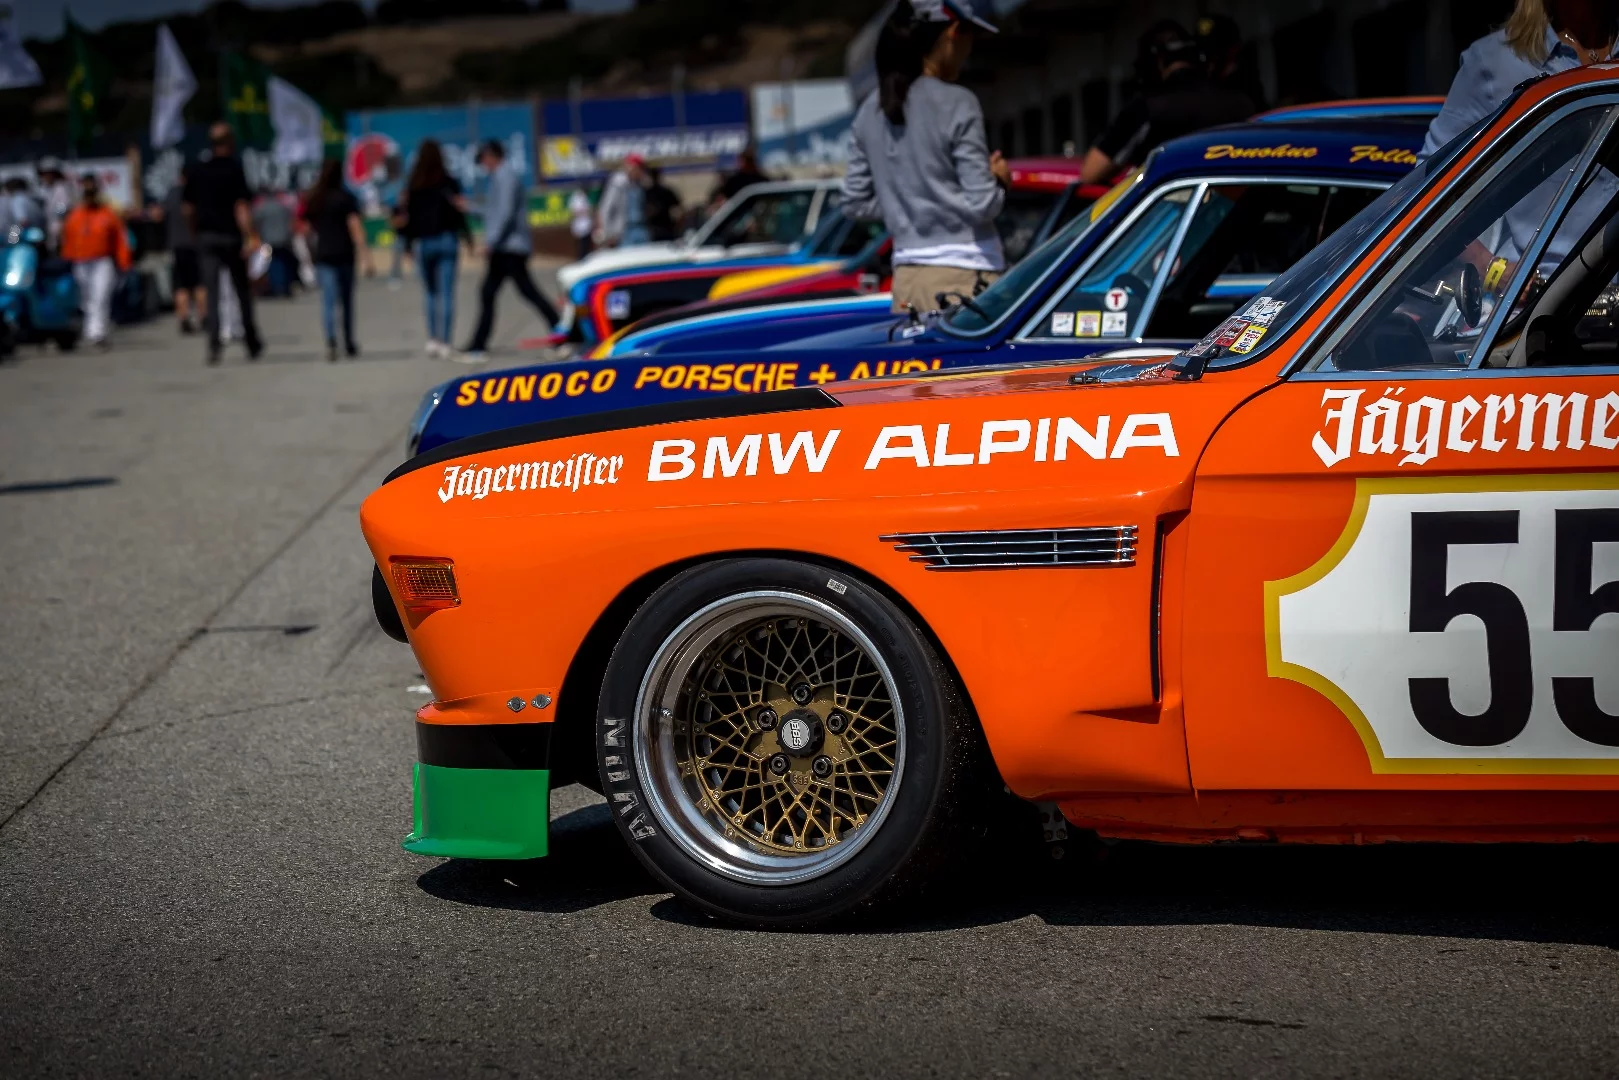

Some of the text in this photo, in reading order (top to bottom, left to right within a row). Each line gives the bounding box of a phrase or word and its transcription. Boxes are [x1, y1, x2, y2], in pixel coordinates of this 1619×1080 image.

[1203, 143, 1318, 160] Donohue
[1111, 293, 1123, 307] T
[456, 369, 618, 407] SUNOCO
[634, 363, 799, 393] PORSCHE
[647, 429, 842, 482] BMW
[863, 412, 1180, 470] ALPINA
[789, 722, 802, 748] BBS
[604, 718, 657, 840] AVON
